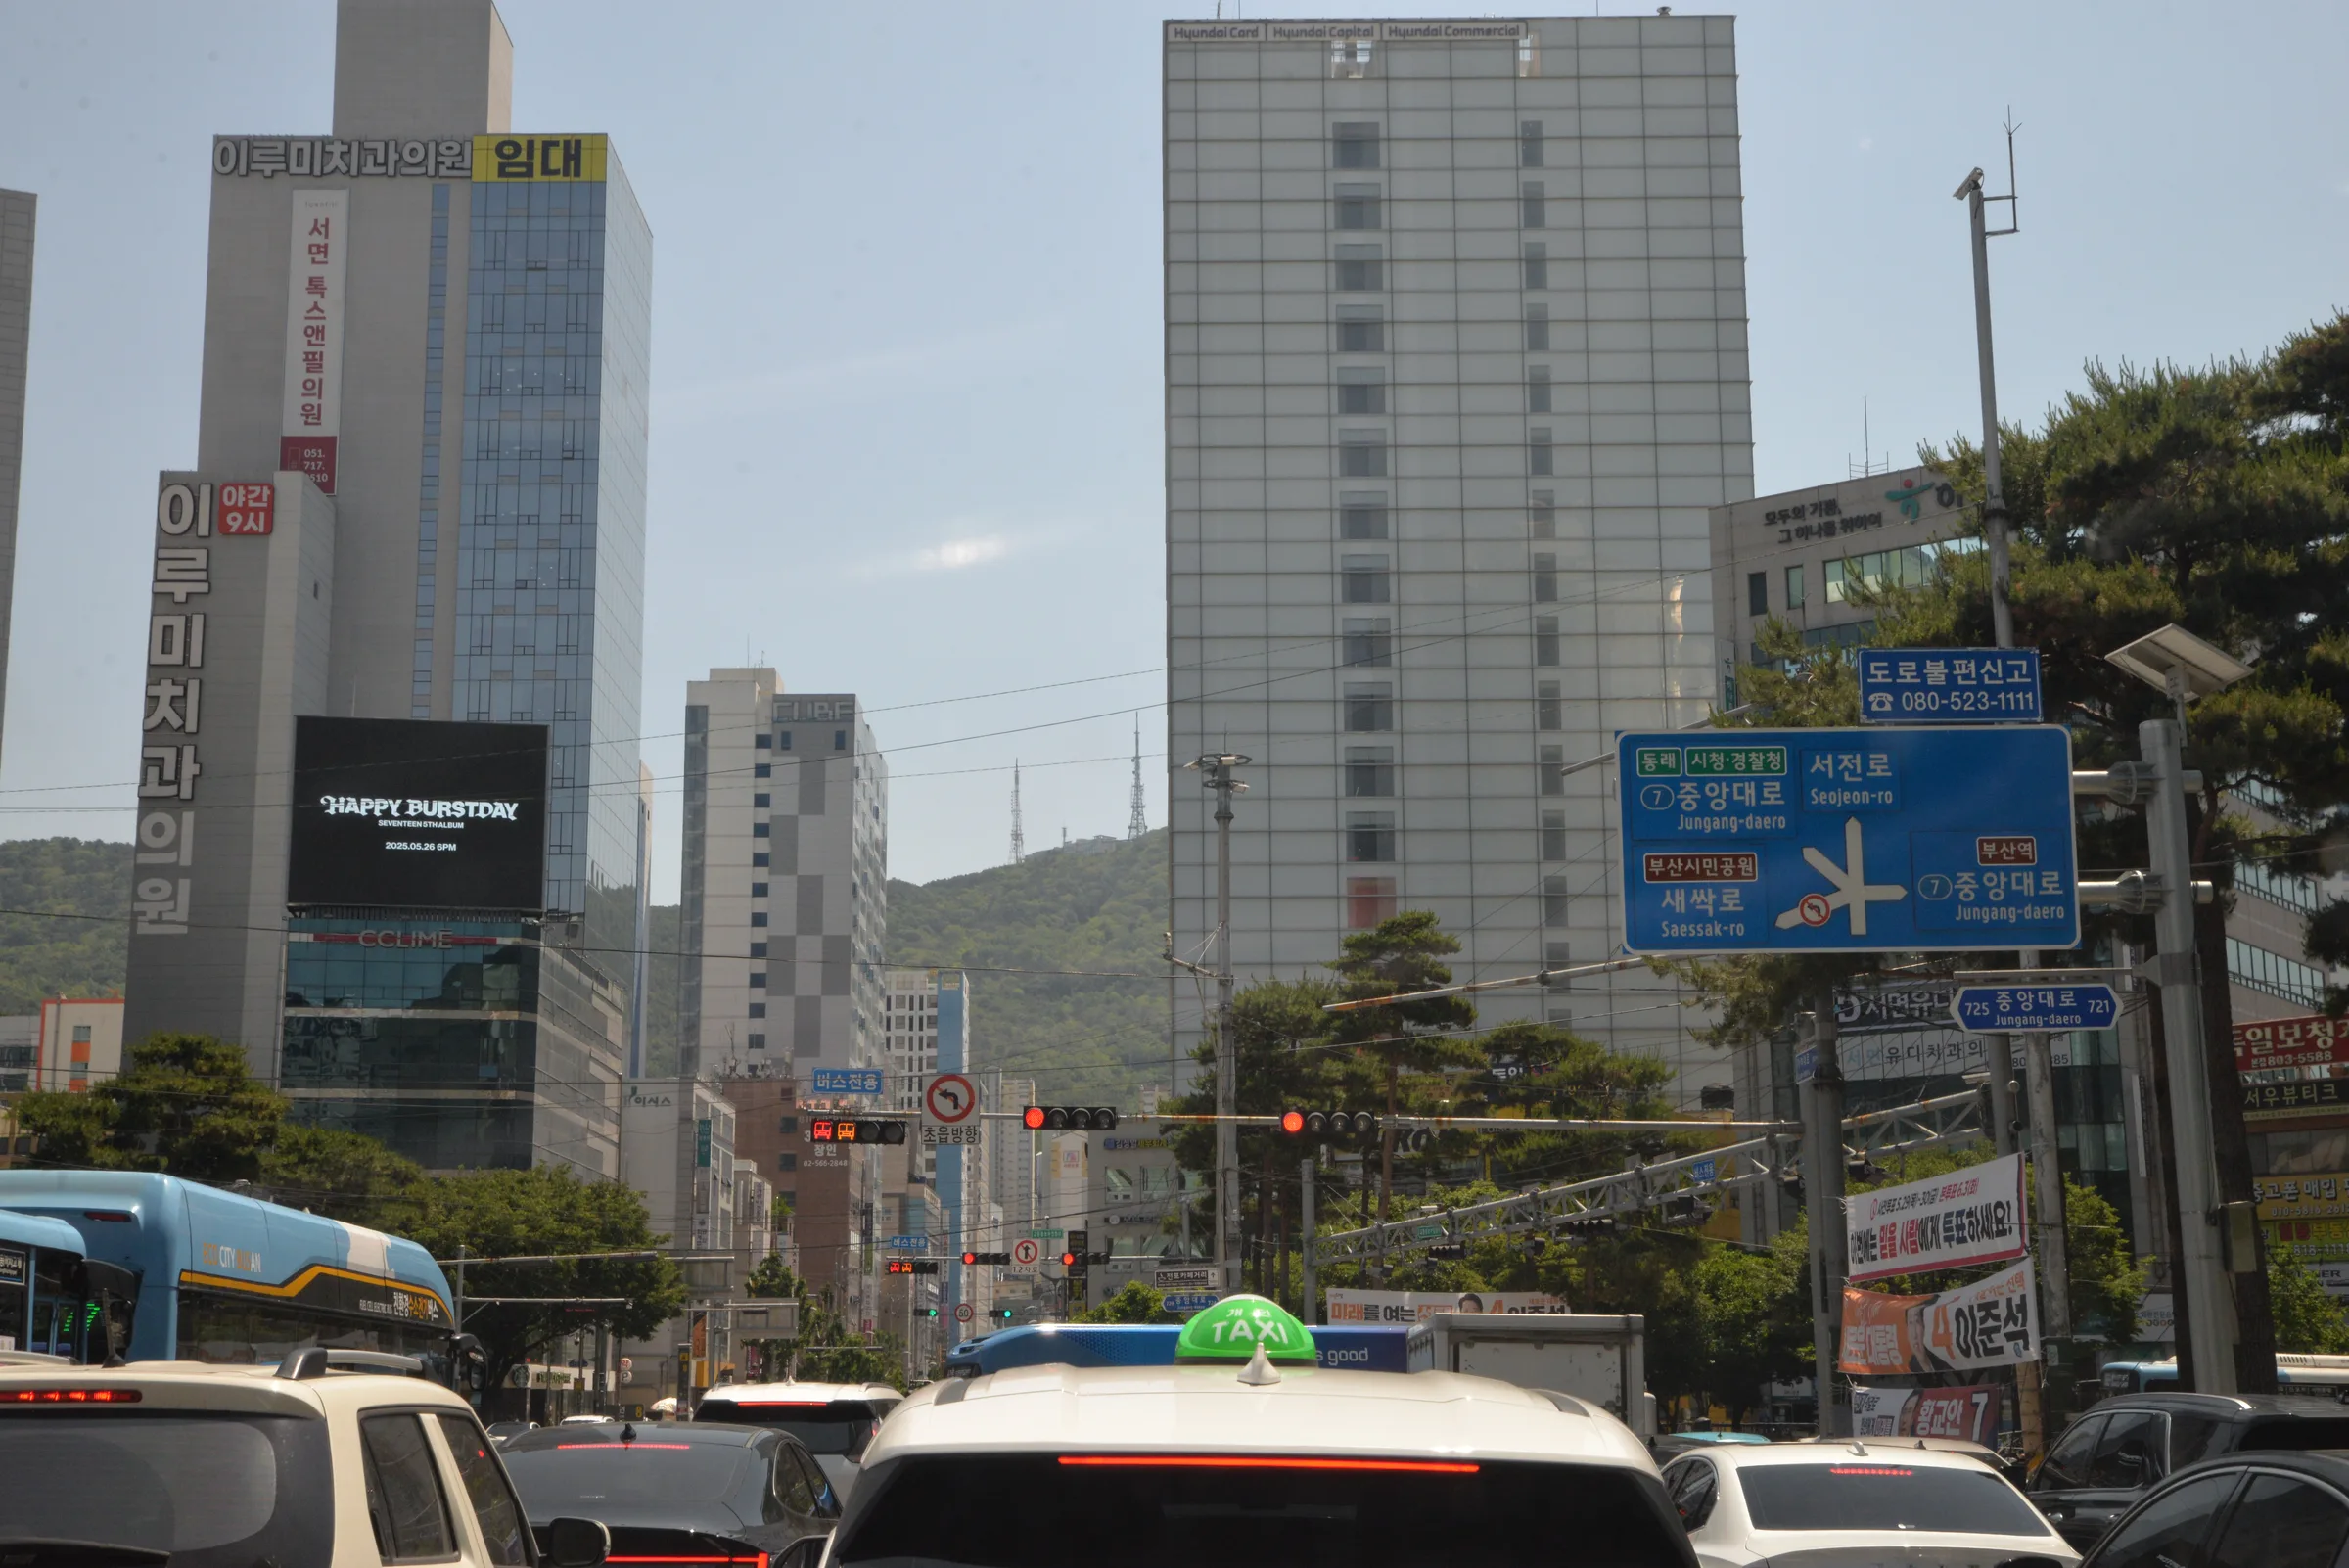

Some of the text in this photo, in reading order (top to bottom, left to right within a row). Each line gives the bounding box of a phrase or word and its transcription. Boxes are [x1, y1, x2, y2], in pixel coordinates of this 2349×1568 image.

[1174, 26, 1259, 41] Hyundai Card
[1273, 26, 1374, 40] Hyundai Capital
[1388, 24, 1520, 39] Hyundai Commercial
[213, 138, 472, 179] 이루미치과의원
[494, 137, 582, 179] 임대
[299, 216, 330, 427] 서면 톡스앤필의원
[303, 448, 326, 458] 051.
[303, 461, 326, 470] 717.
[307, 473, 329, 483] 510
[221, 484, 272, 508] 야간
[225, 510, 266, 533] 9시
[1867, 658, 2032, 686] 도로불편신고
[133, 482, 213, 936] 이루미치과의원
[1901, 690, 2035, 712] 080-523-1111
[1641, 749, 1783, 771] 동래 시청·경찰청
[1809, 753, 1893, 782] 서전로
[1652, 781, 1786, 811] 7 중앙대로
[1810, 787, 1894, 807] Seojeon-ro
[320, 795, 519, 821] HAPPY BURSTDAY
[378, 819, 423, 828] SEVENTEEN
[1677, 813, 1787, 832] Jungang-daero
[385, 842, 457, 852] 2025.05.26 6PM
[1980, 840, 2034, 860] 부산역
[1648, 857, 1755, 878] 부산시민공원
[1930, 870, 2064, 900] 7 중앙대로
[1662, 887, 1745, 913] 새싹로
[1955, 902, 2065, 922] Jungang-daero
[1661, 921, 1745, 938] Saessak-ro
[1965, 991, 2110, 1016] 725 중앙대로 721
[1994, 1013, 2083, 1027] Jungang-daero
[1847, 1039, 1985, 1067] 서면유디치과의
[2267, 1050, 2333, 1066] 803-5588
[817, 1071, 878, 1091] 버스전용
[2244, 1083, 2338, 1108] 서우뷰티크
[924, 1126, 978, 1143] 초읍방향
[814, 1144, 837, 1156] 장인
[1942, 1200, 2013, 1250] 투표하세요!
[893, 1238, 926, 1248] 버스전용
[219, 1245, 236, 1268] CITY
[958, 1309, 969, 1317] 50
[1331, 1302, 1380, 1321] 미래를
[1383, 1304, 1415, 1322] 여는
[1211, 1318, 1284, 1343] TAXI
[1931, 1303, 1956, 1360] 4
[1955, 1293, 2030, 1359] 이준석
[1327, 1347, 1369, 1366] good
[1916, 1399, 1964, 1437] 황교안
[1971, 1392, 1989, 1442] 7
